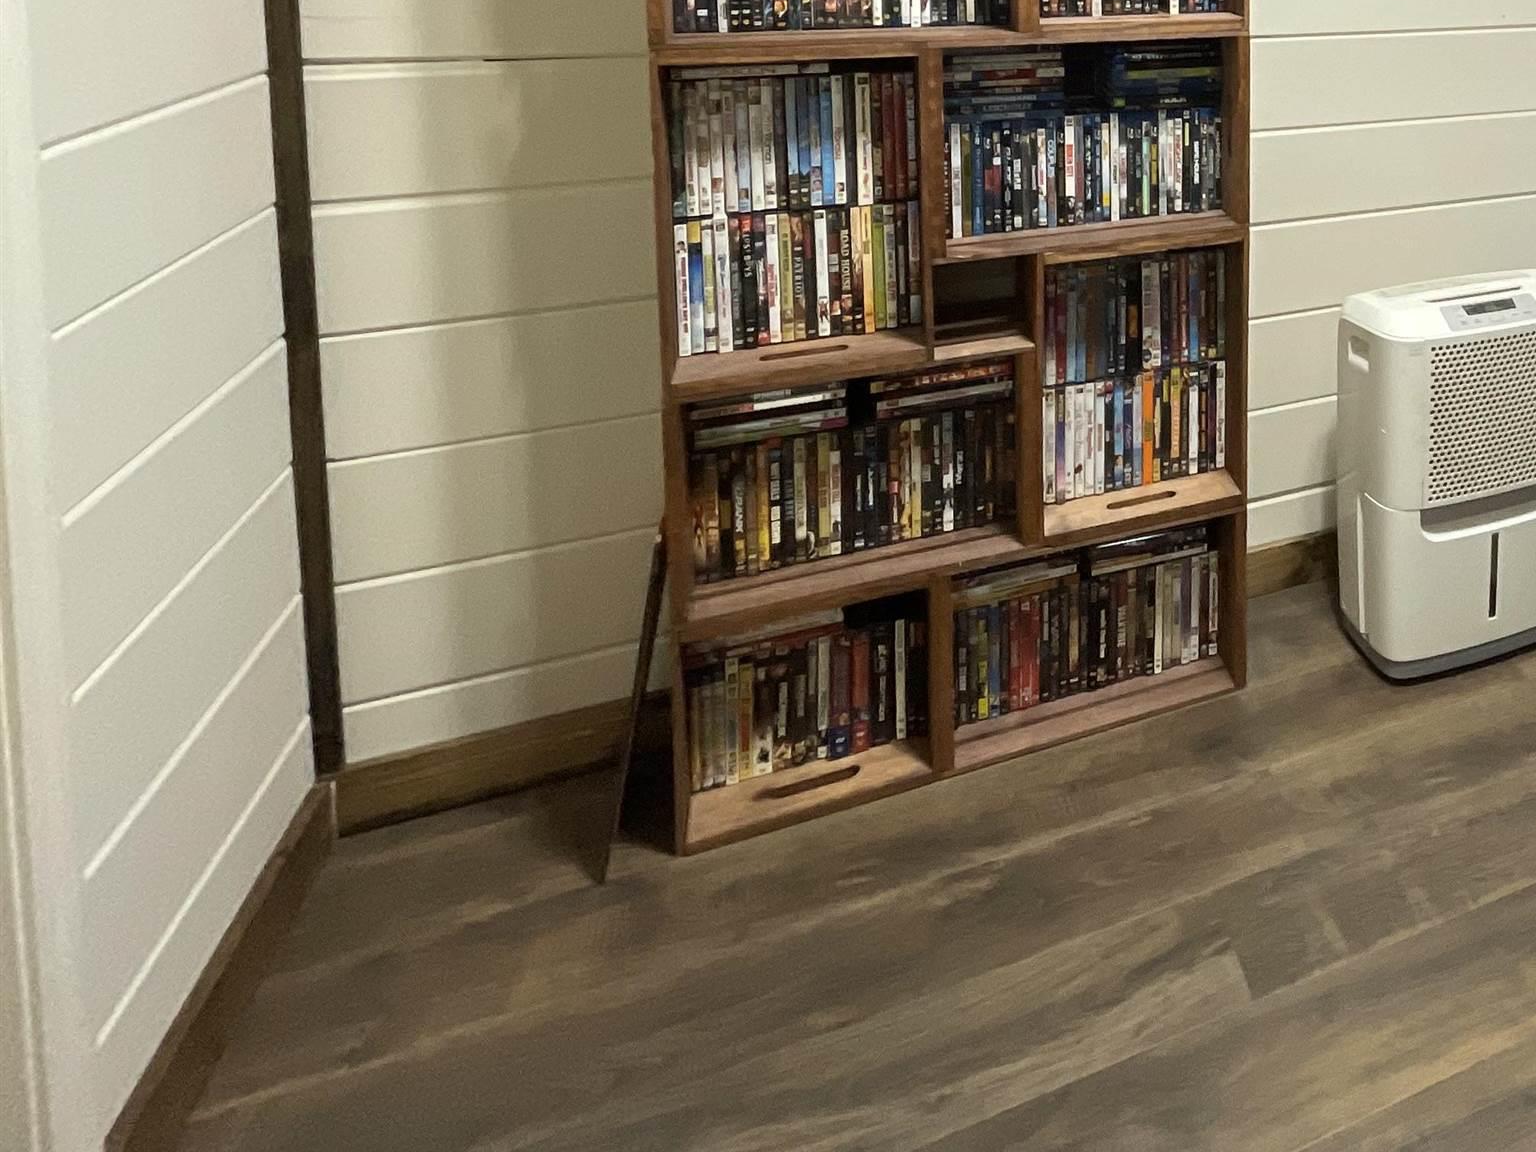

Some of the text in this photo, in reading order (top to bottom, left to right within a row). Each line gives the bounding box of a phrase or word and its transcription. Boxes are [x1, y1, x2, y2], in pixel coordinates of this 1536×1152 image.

[794, 256, 804, 300] PATRIOT
[840, 229, 851, 291] ROAD HOUSE
